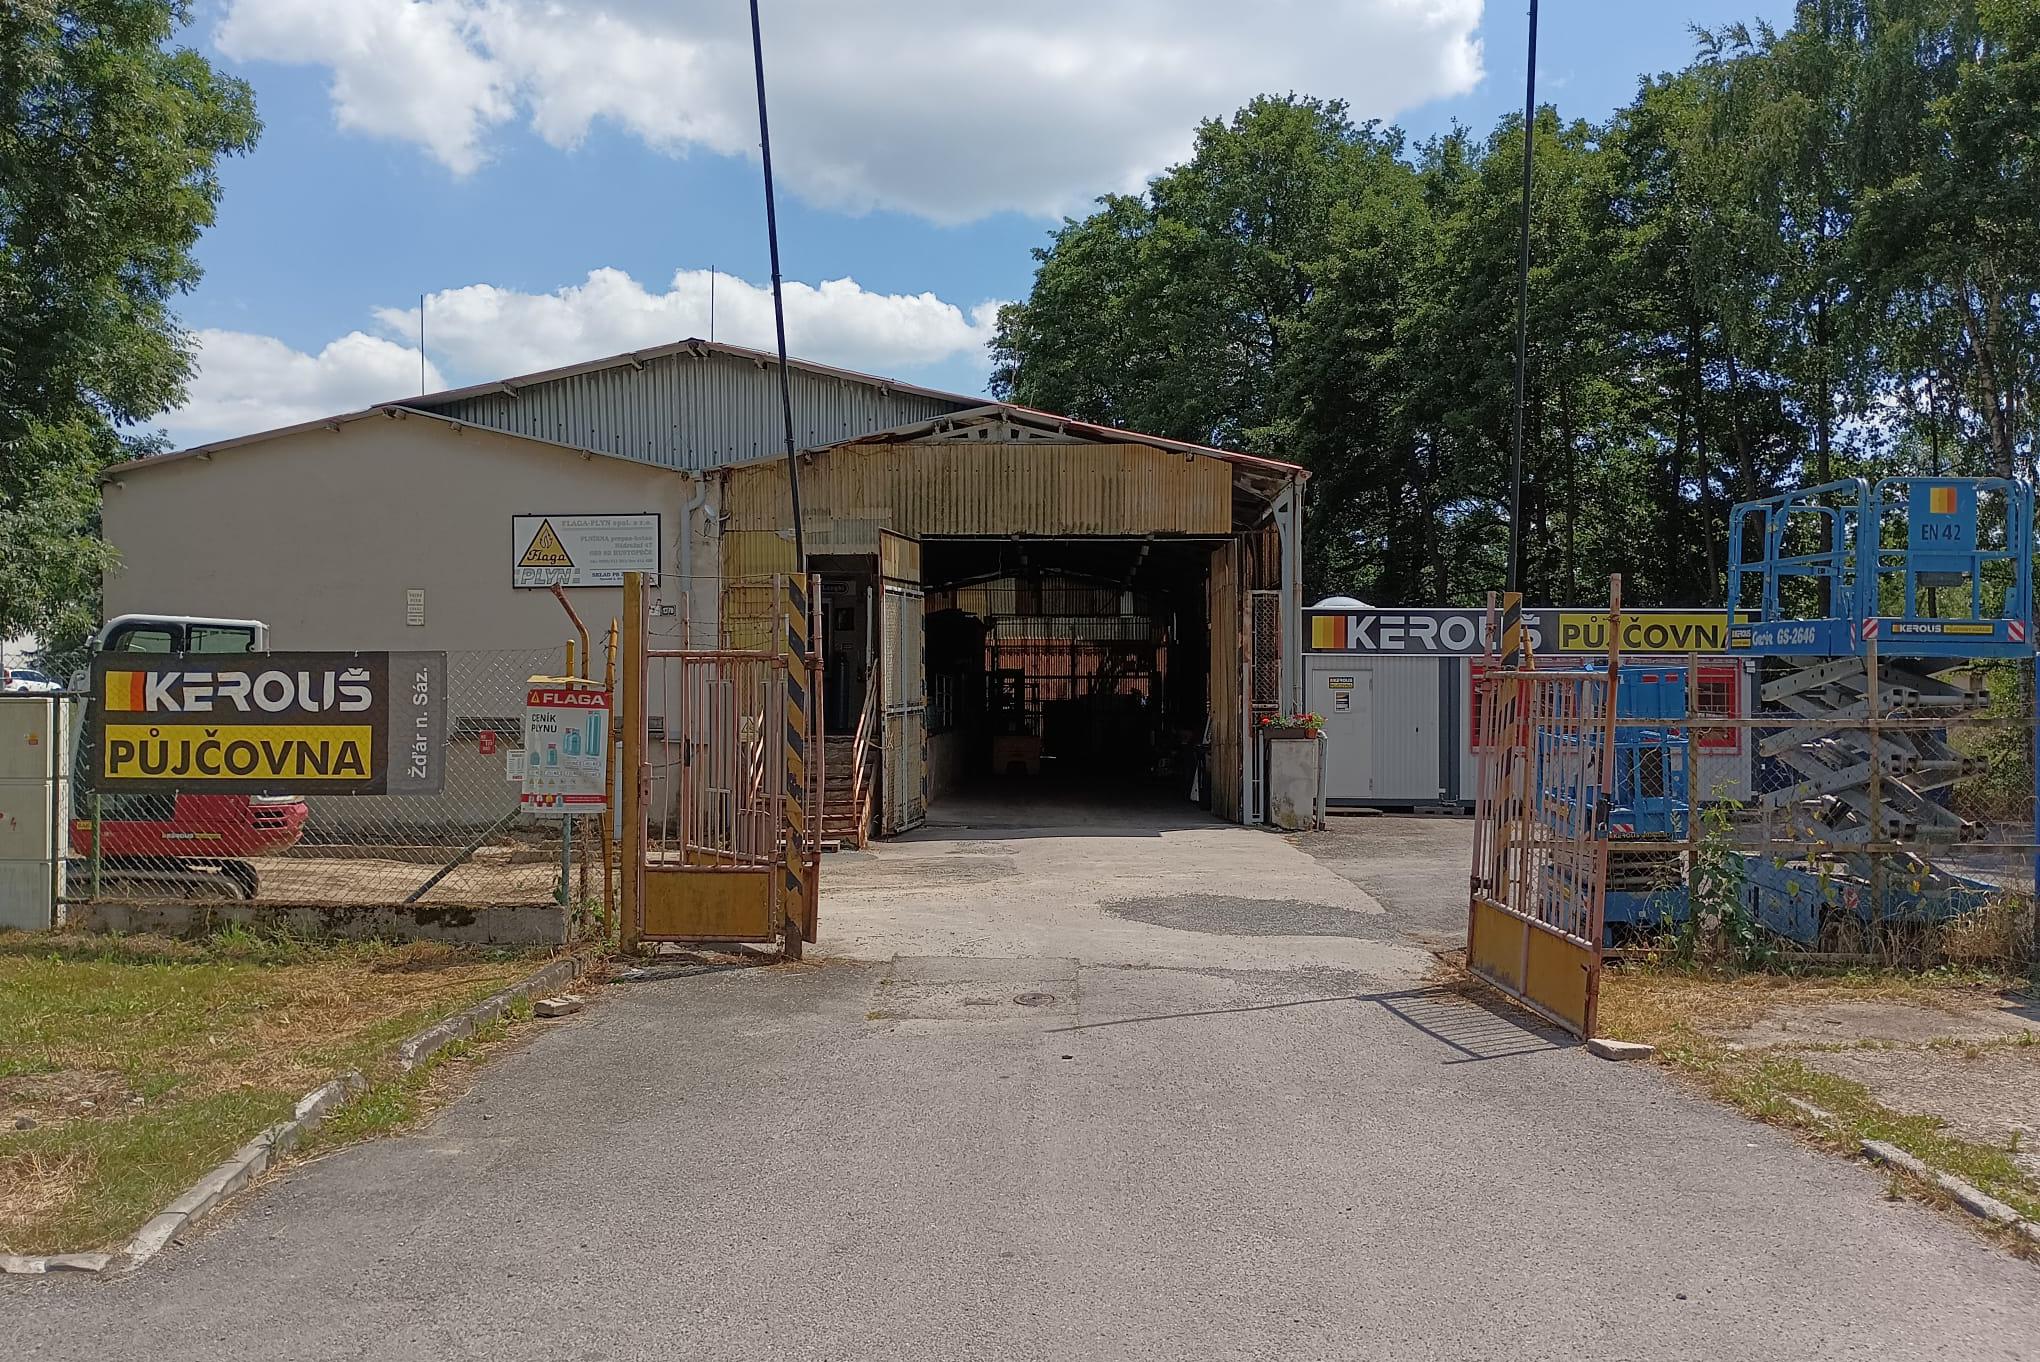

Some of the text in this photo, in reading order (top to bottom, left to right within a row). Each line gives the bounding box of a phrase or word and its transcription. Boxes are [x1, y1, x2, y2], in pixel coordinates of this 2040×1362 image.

[562, 520, 611, 528] FLAGA-PLYN
[1921, 524, 1961, 541] EN 42
[527, 549, 567, 564] Flaga
[520, 568, 572, 585] PLYN
[1563, 615, 1728, 649] PŮČOVN
[1752, 630, 1774, 647] Genie
[1776, 626, 1816, 646] GS-2646
[145, 667, 373, 712] KEROUŠ
[543, 693, 605, 706] FLAGA
[407, 666, 429, 779] Žďár n. Sáz.
[531, 711, 557, 723] CENÍK
[531, 724, 557, 733] PLYNU
[109, 727, 366, 777] PŮJČOVNA
